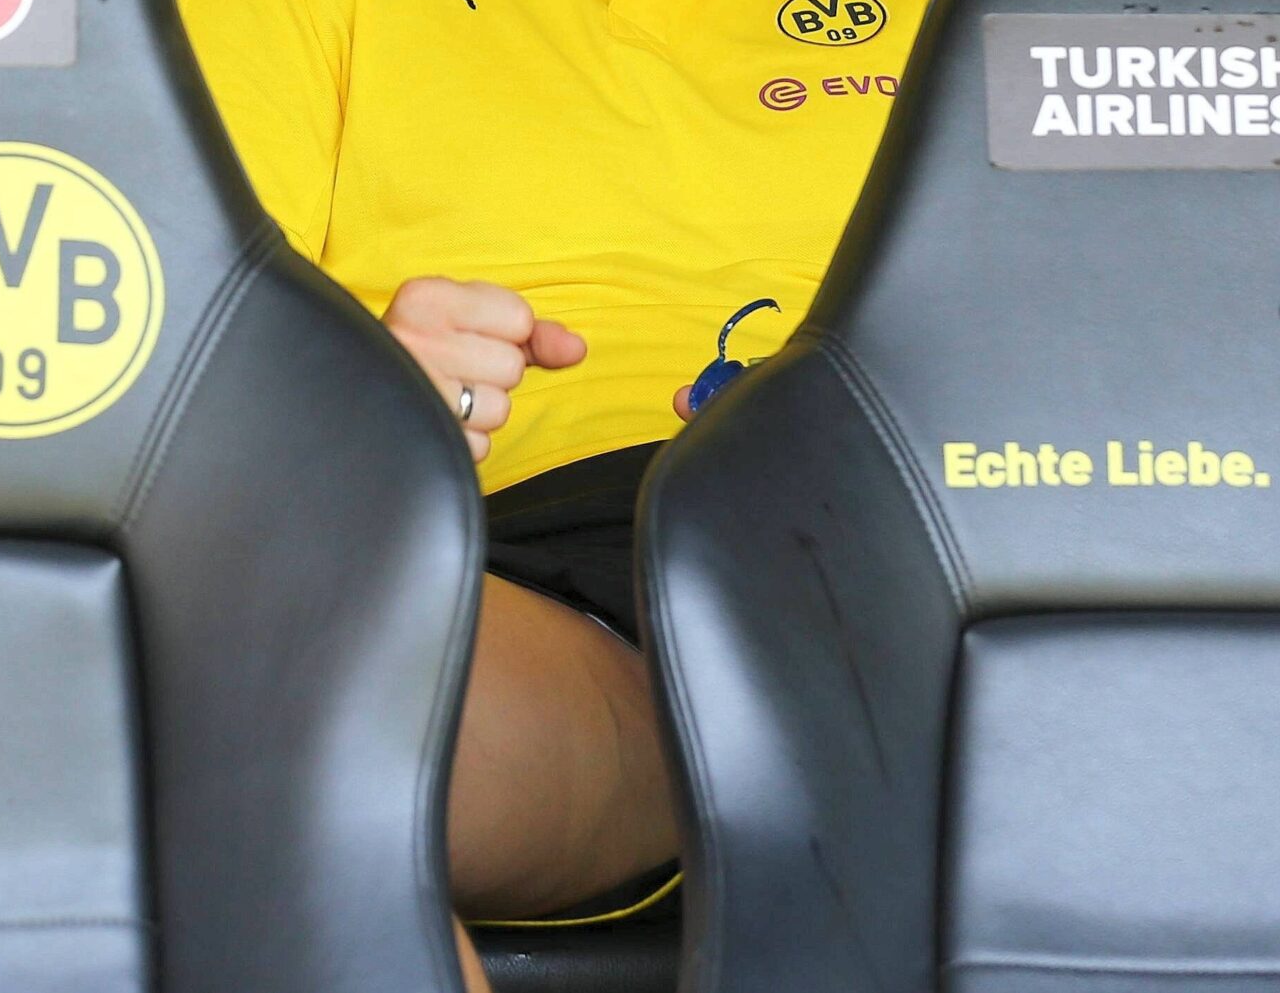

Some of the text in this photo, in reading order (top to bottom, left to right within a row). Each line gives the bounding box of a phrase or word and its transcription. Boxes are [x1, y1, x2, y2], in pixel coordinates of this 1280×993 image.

[826, 27, 858, 41] 09
[1032, 94, 1280, 136] AIRLINE
[943, 441, 1271, 488] Echte Liebe.
